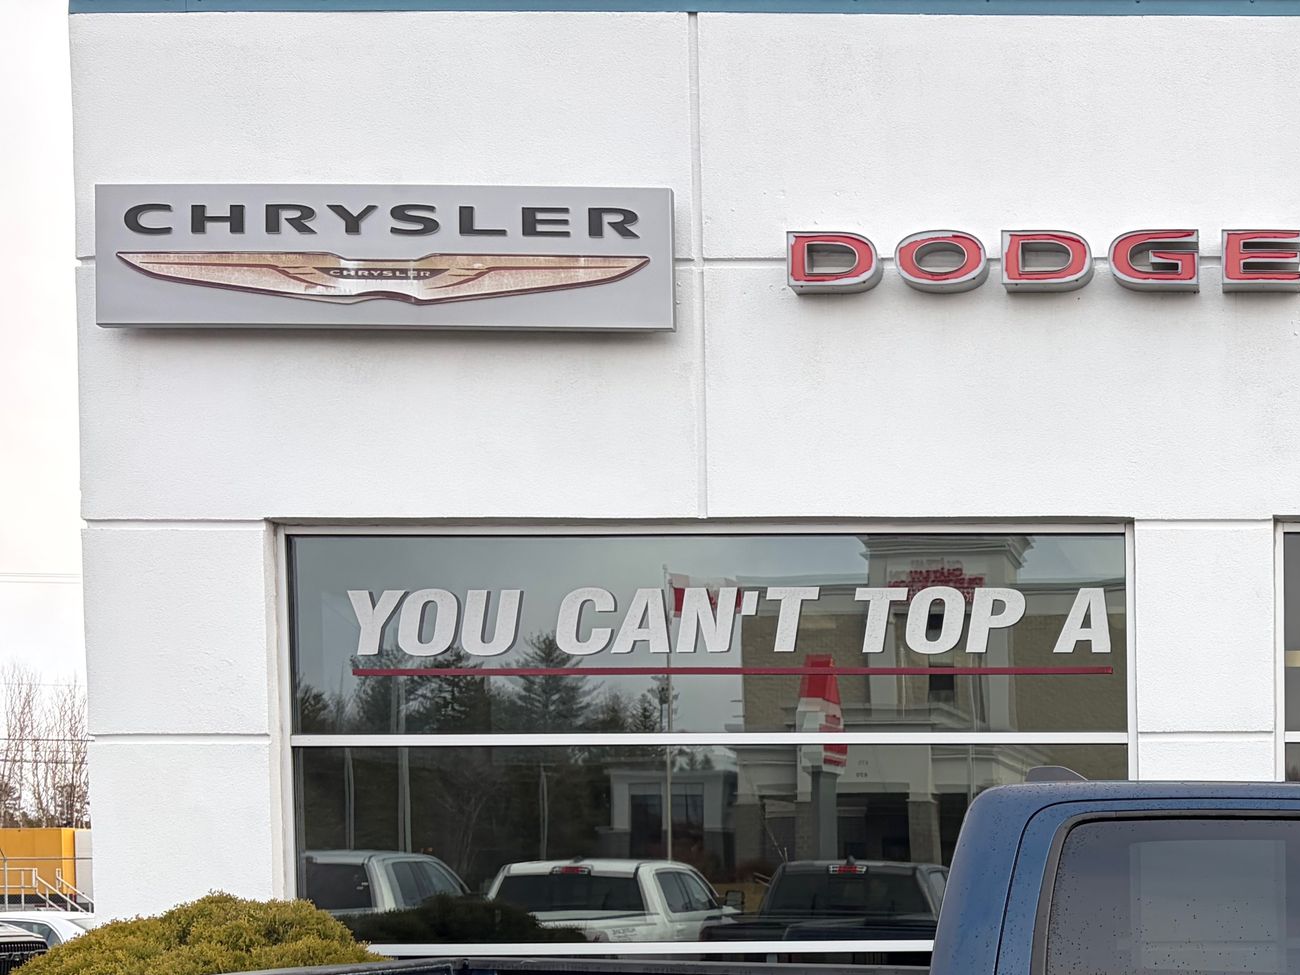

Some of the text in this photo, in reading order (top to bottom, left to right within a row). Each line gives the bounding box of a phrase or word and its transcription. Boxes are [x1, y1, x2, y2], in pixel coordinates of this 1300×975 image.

[122, 202, 641, 240] CHRYSLER
[329, 269, 431, 278] CHRYSLER
[346, 586, 1114, 658] YOU CAN'T TOP A
